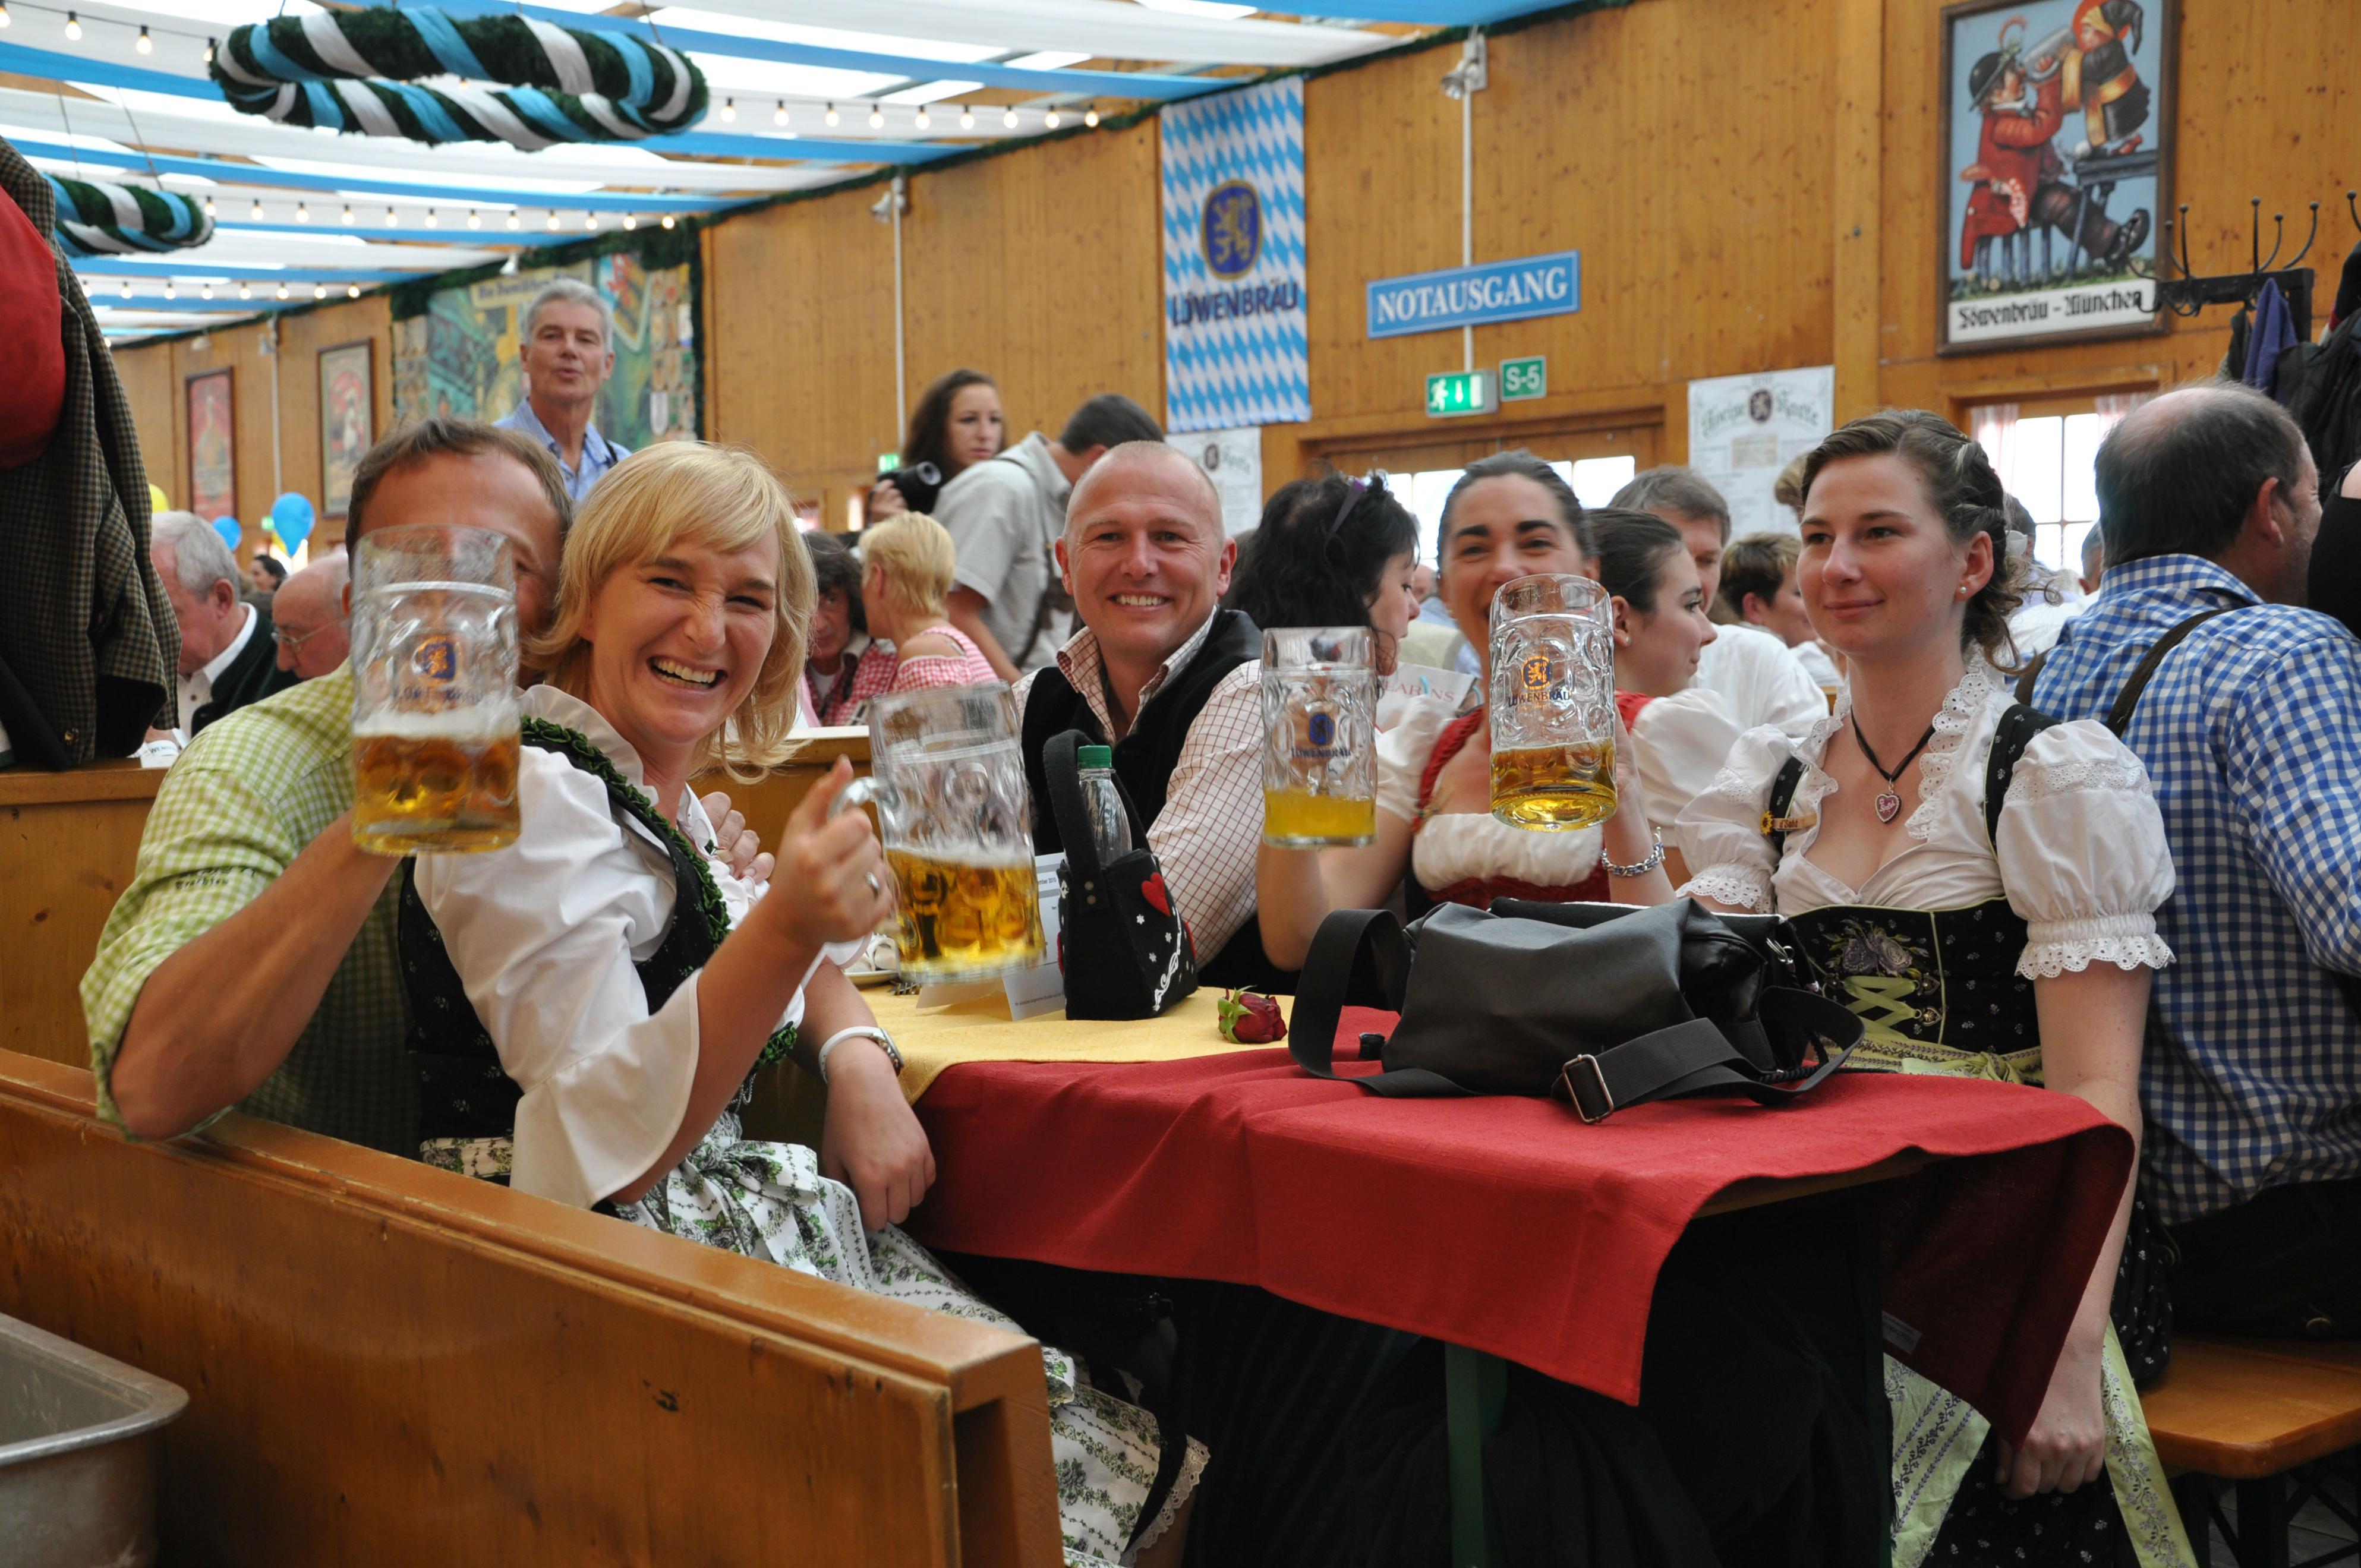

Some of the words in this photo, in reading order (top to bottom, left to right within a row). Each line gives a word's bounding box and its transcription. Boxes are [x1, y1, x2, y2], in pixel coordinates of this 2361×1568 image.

[1172, 279, 1298, 327] LÖWENBRÄU
[1377, 267, 1568, 324] NOTAUSGANG
[1958, 299, 2049, 329] Löwenbräu
[2064, 288, 2142, 317] München
[1505, 364, 1541, 391] S-5
